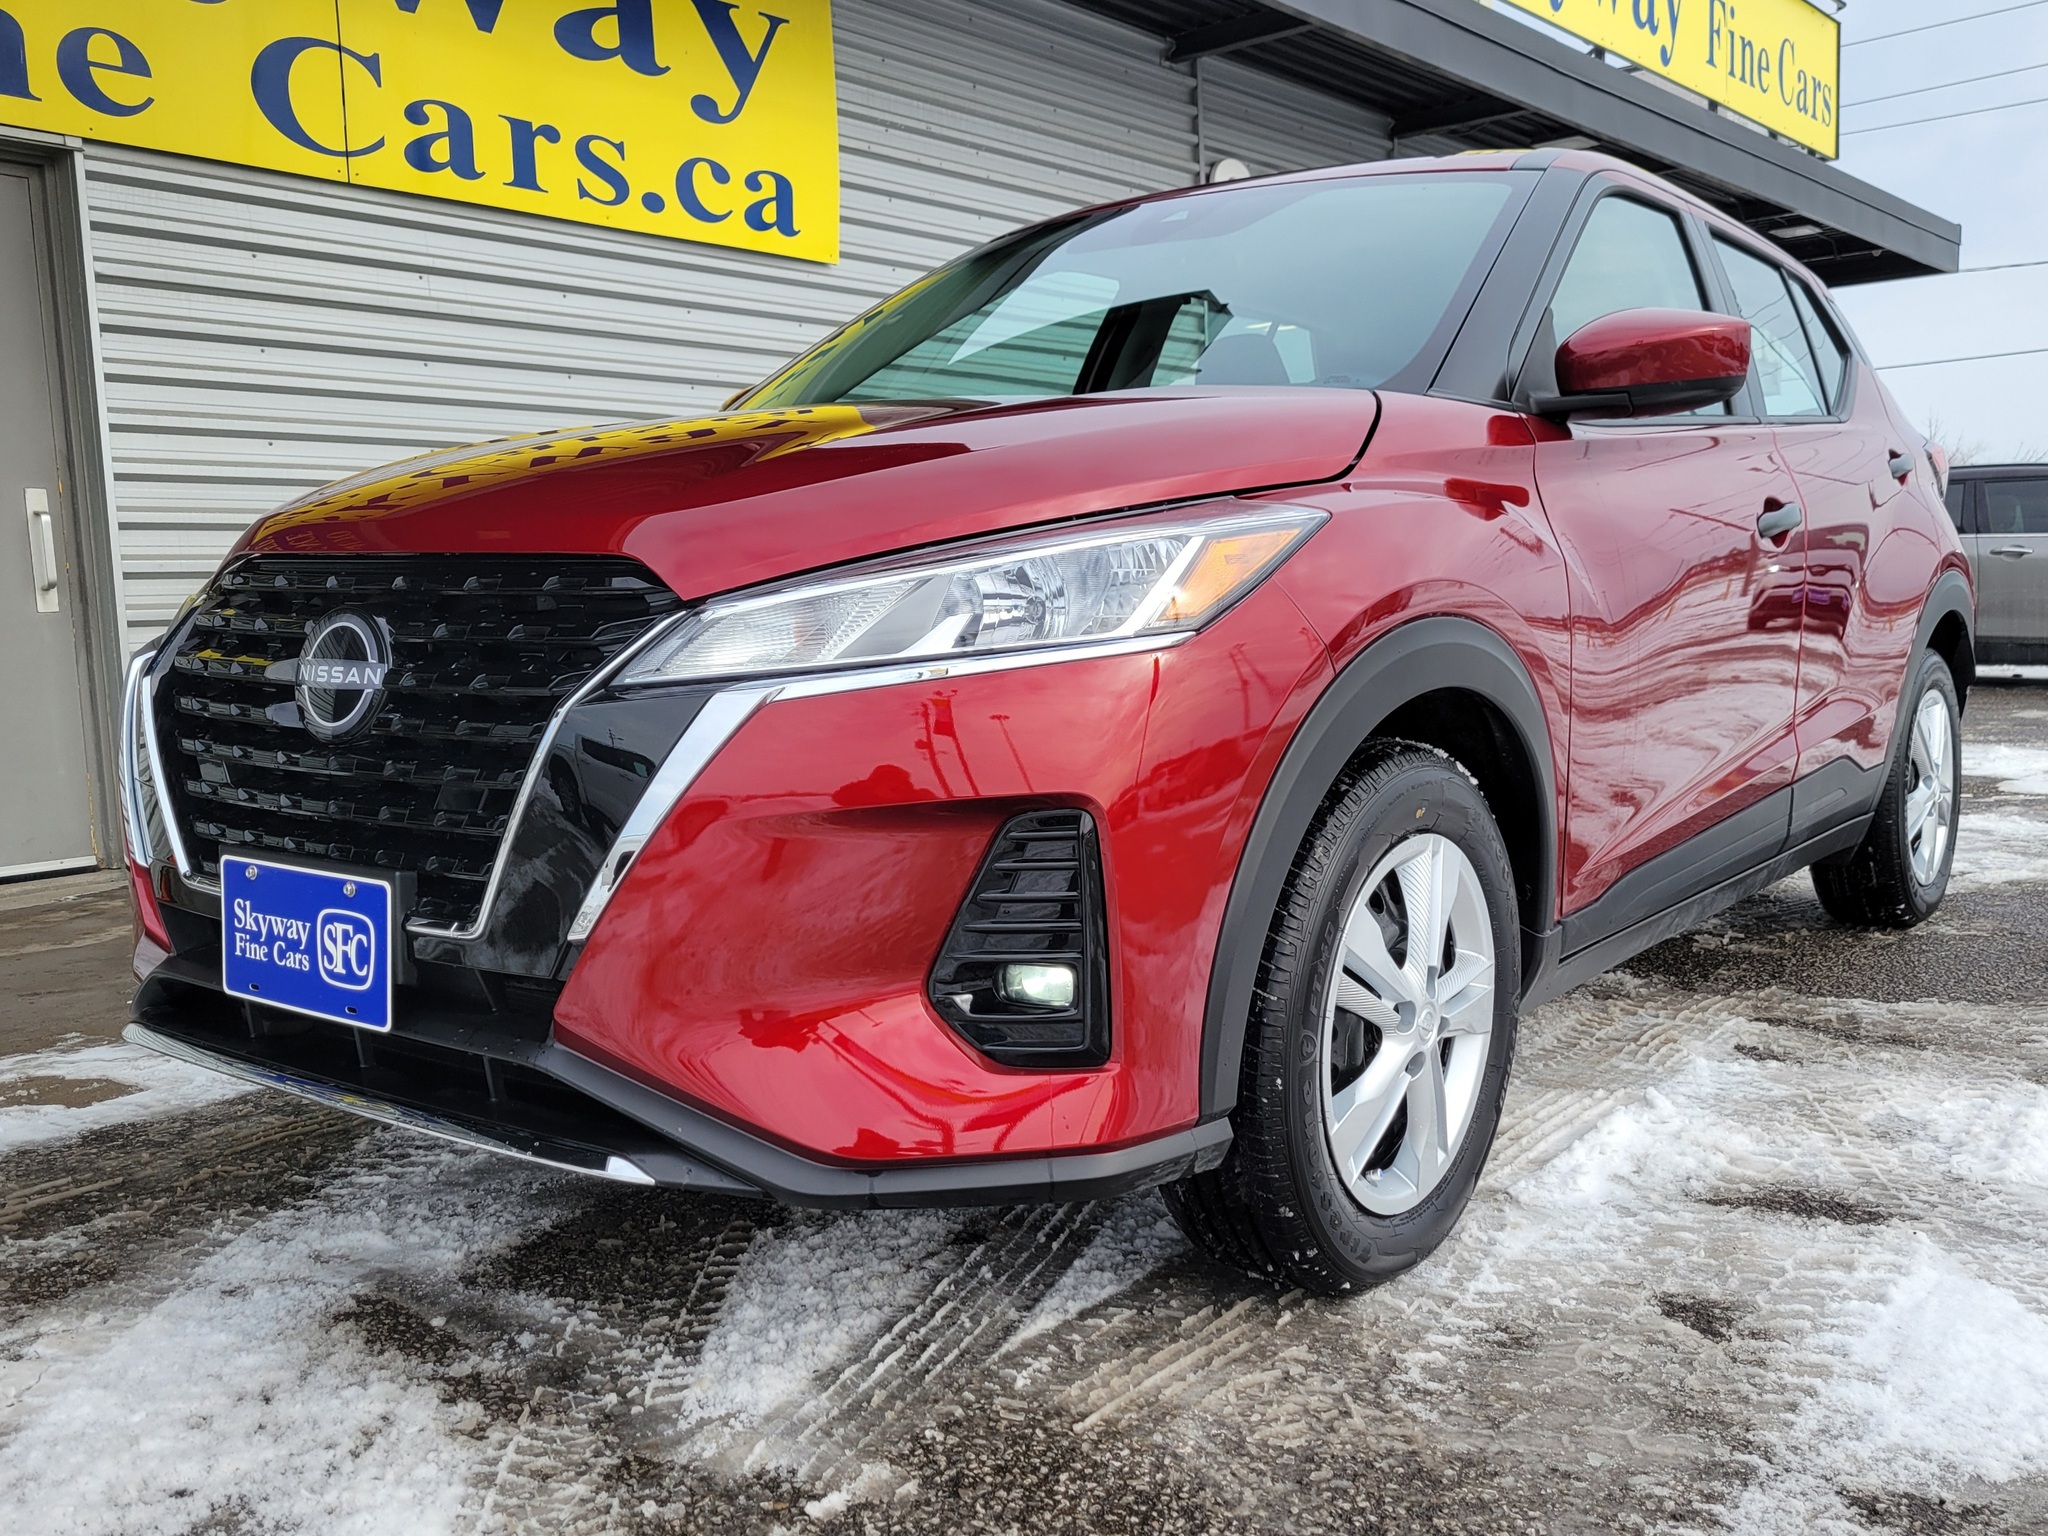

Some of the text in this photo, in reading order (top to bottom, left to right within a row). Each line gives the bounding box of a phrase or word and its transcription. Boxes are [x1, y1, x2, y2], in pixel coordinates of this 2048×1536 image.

[1706, 0, 1771, 94] Fine
[1778, 38, 1832, 128] Cars
[251, 37, 802, 237] Cars.ca
[299, 664, 383, 686] NISSAN
[233, 897, 311, 950] Skyway
[323, 921, 369, 978] SFC
[234, 931, 310, 972] Fine Cars
